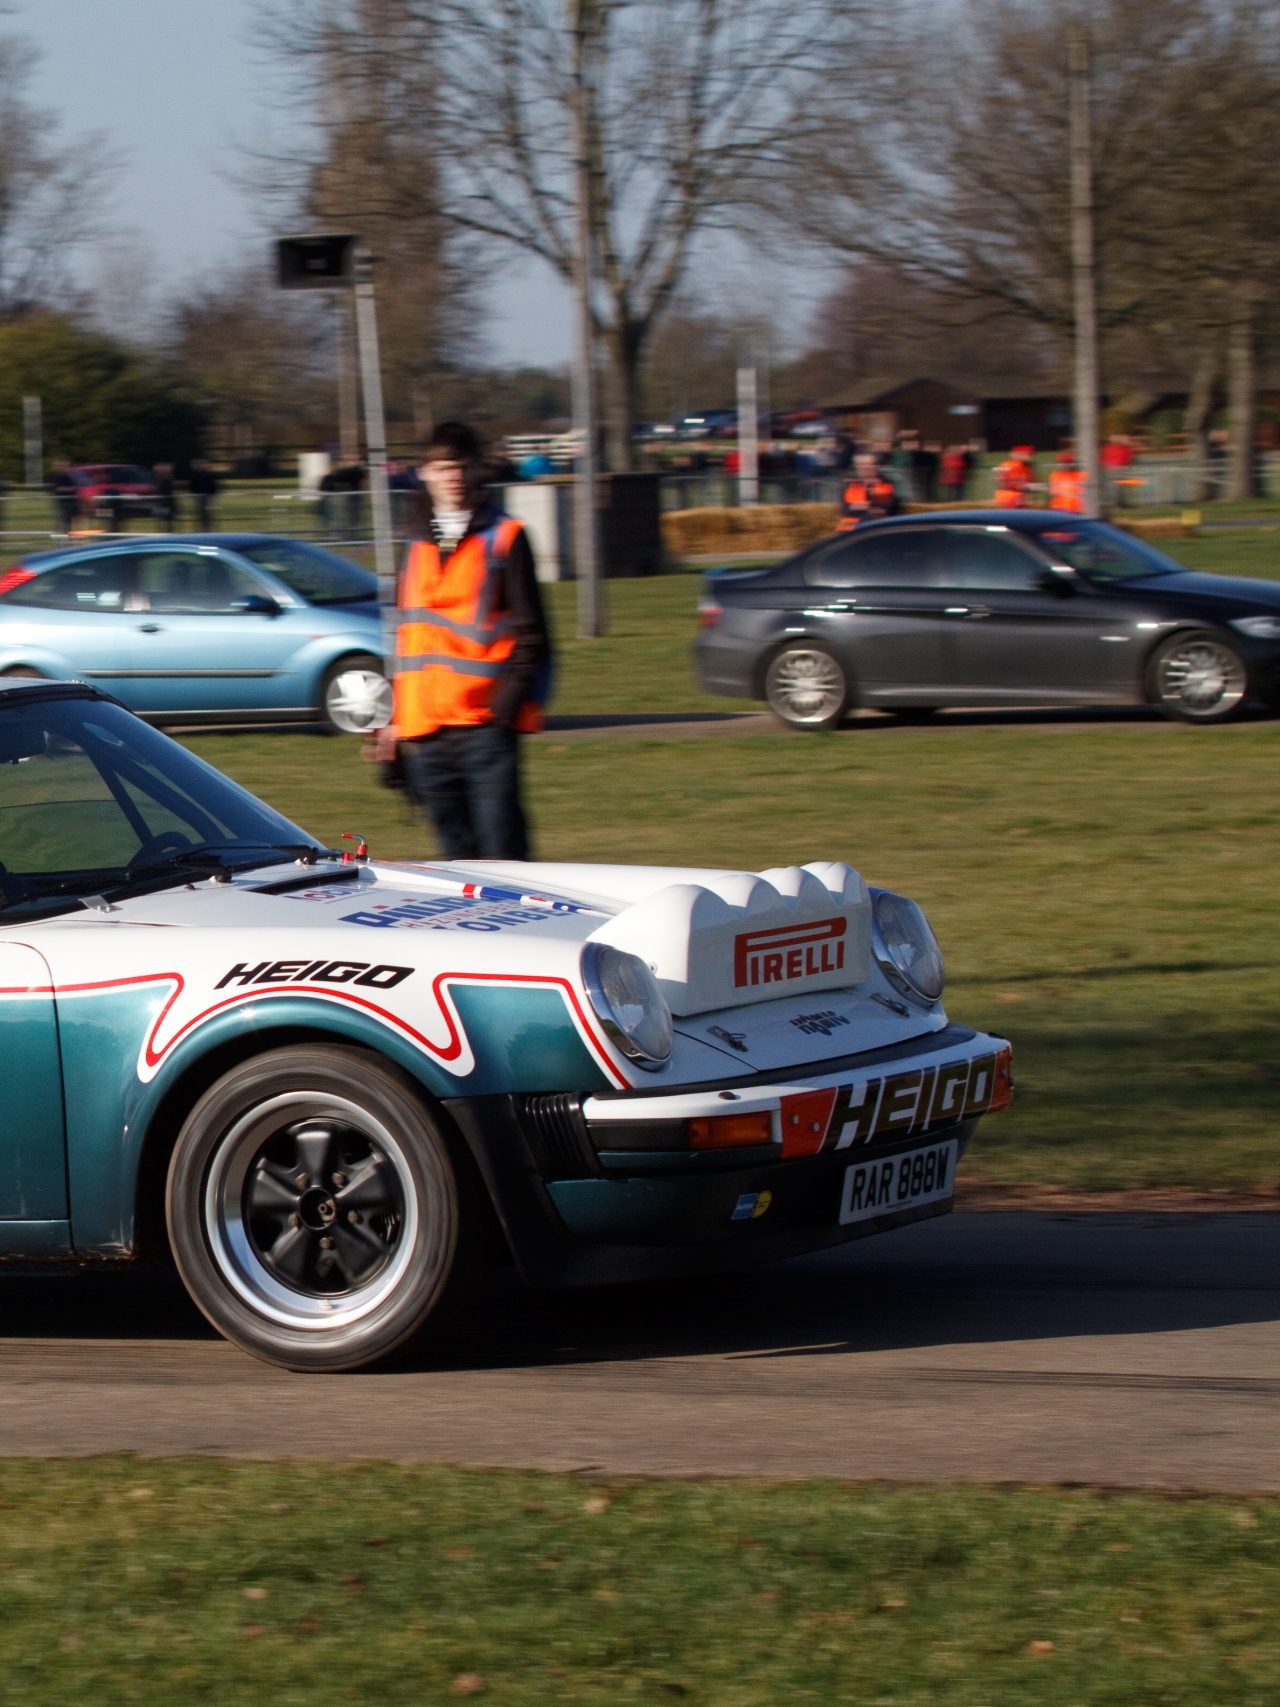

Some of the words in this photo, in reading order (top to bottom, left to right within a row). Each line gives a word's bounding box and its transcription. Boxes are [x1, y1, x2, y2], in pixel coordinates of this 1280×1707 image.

[213, 960, 415, 990] HEIGO
[734, 916, 847, 988] PIRELLI
[817, 1052, 997, 1154] HEIGO
[850, 1156, 895, 1213] RAR
